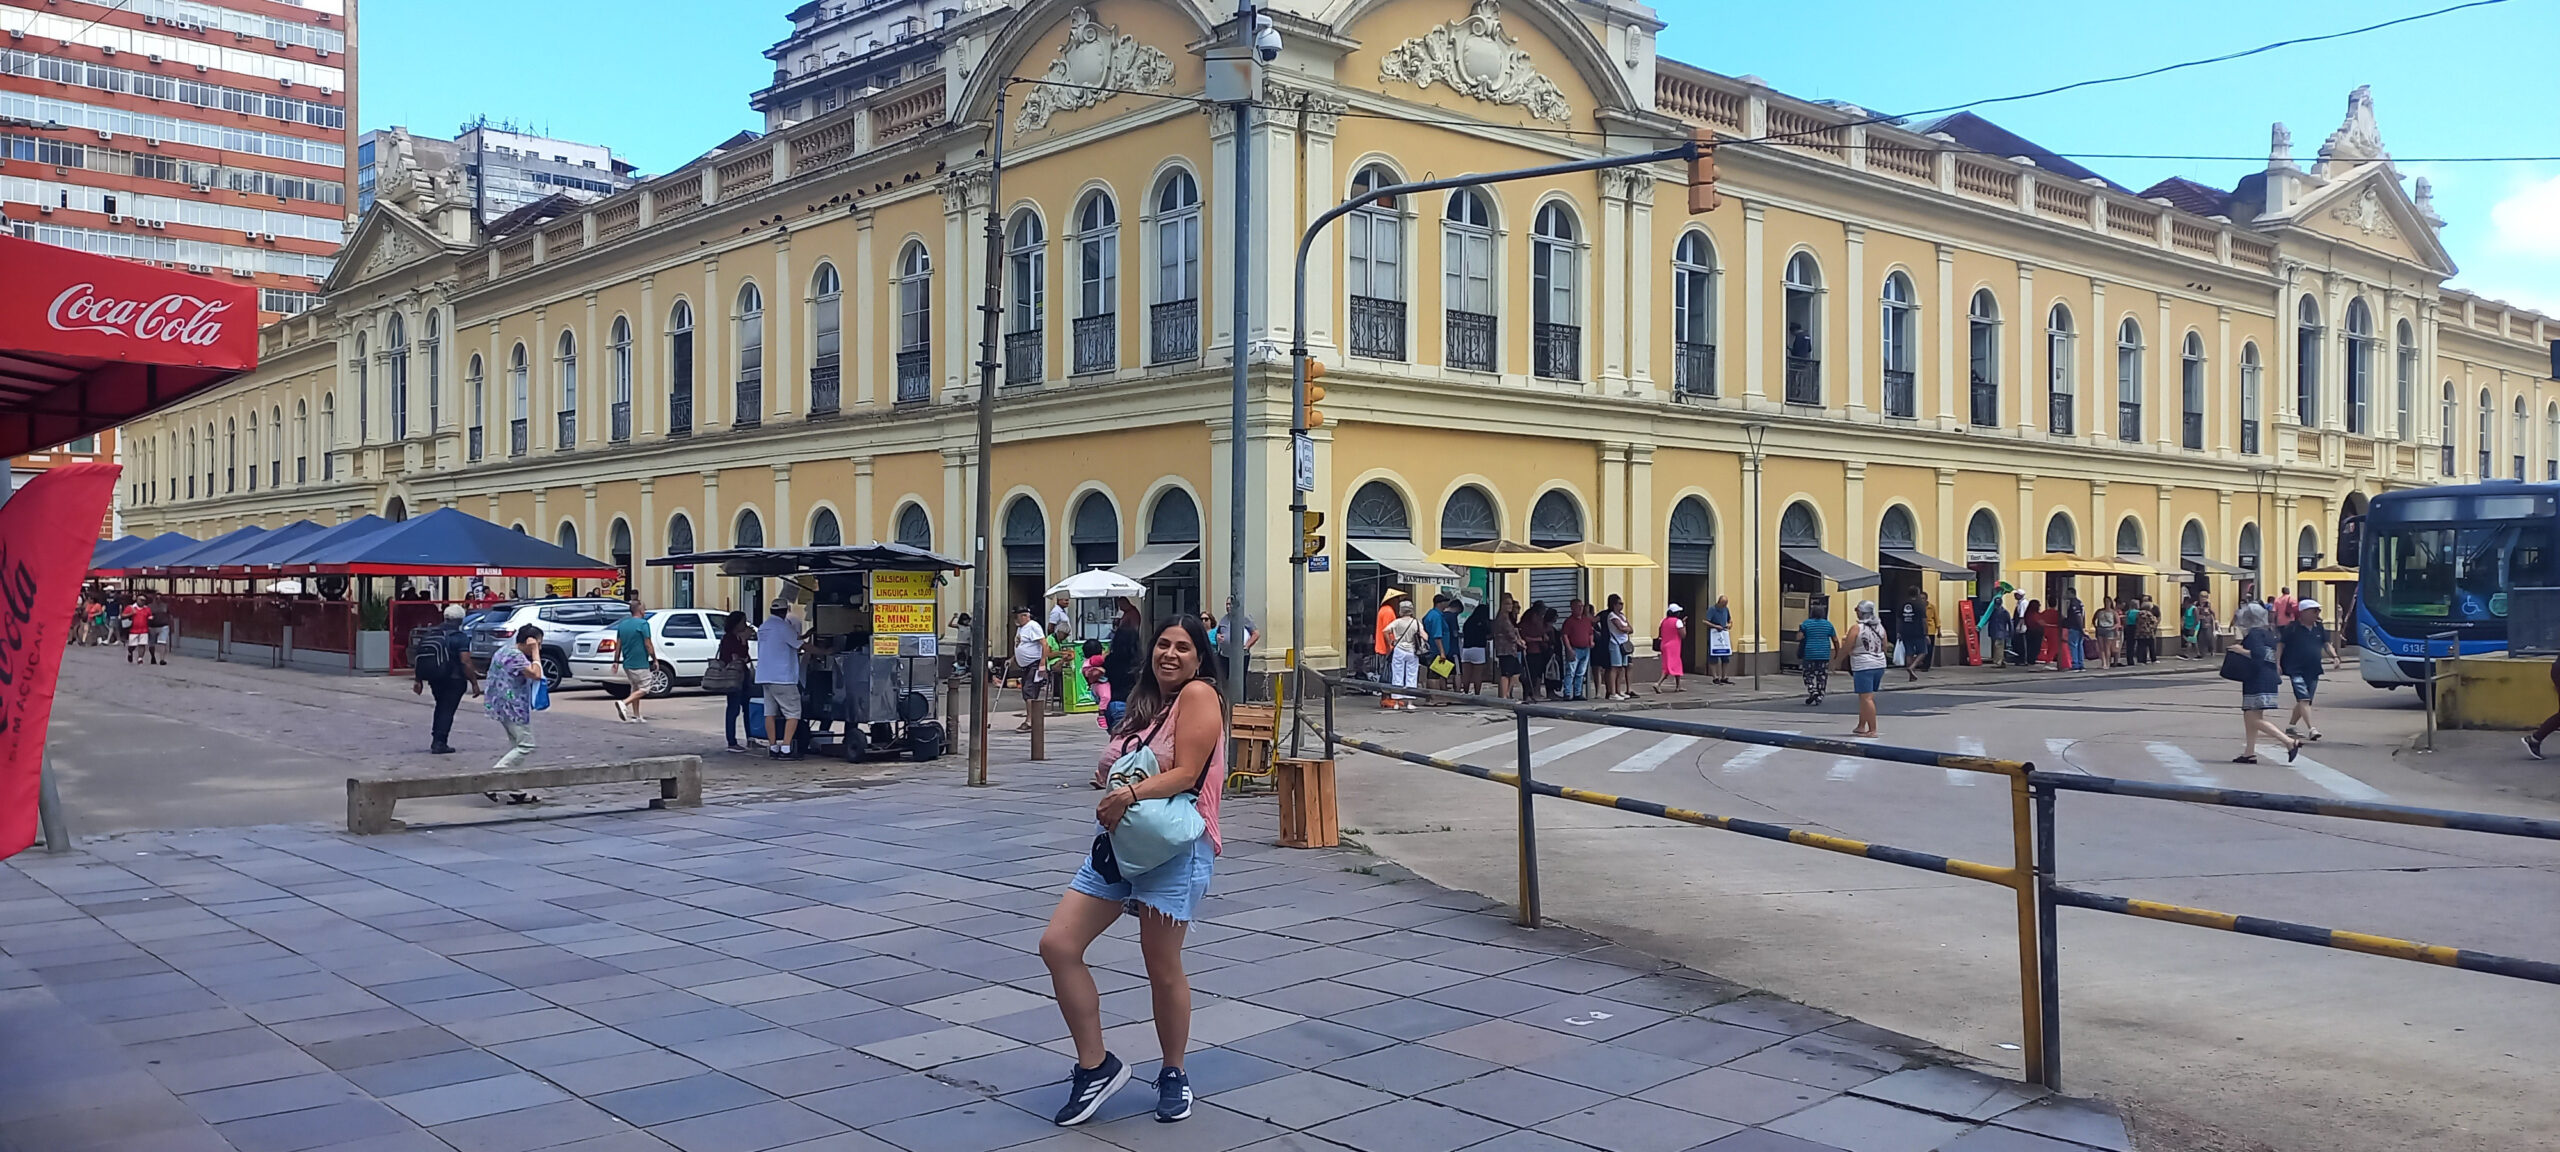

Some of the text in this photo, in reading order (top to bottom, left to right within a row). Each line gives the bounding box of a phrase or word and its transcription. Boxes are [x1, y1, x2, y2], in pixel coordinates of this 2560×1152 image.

[47, 283, 234, 346] Coca-Cola
[876, 575, 909, 583] SALSICHA
[1403, 575, 1431, 584] MARTINI
[876, 588, 909, 598] LINGUIÇA
[875, 615, 885, 623] R:
[888, 615, 910, 623] MINI
